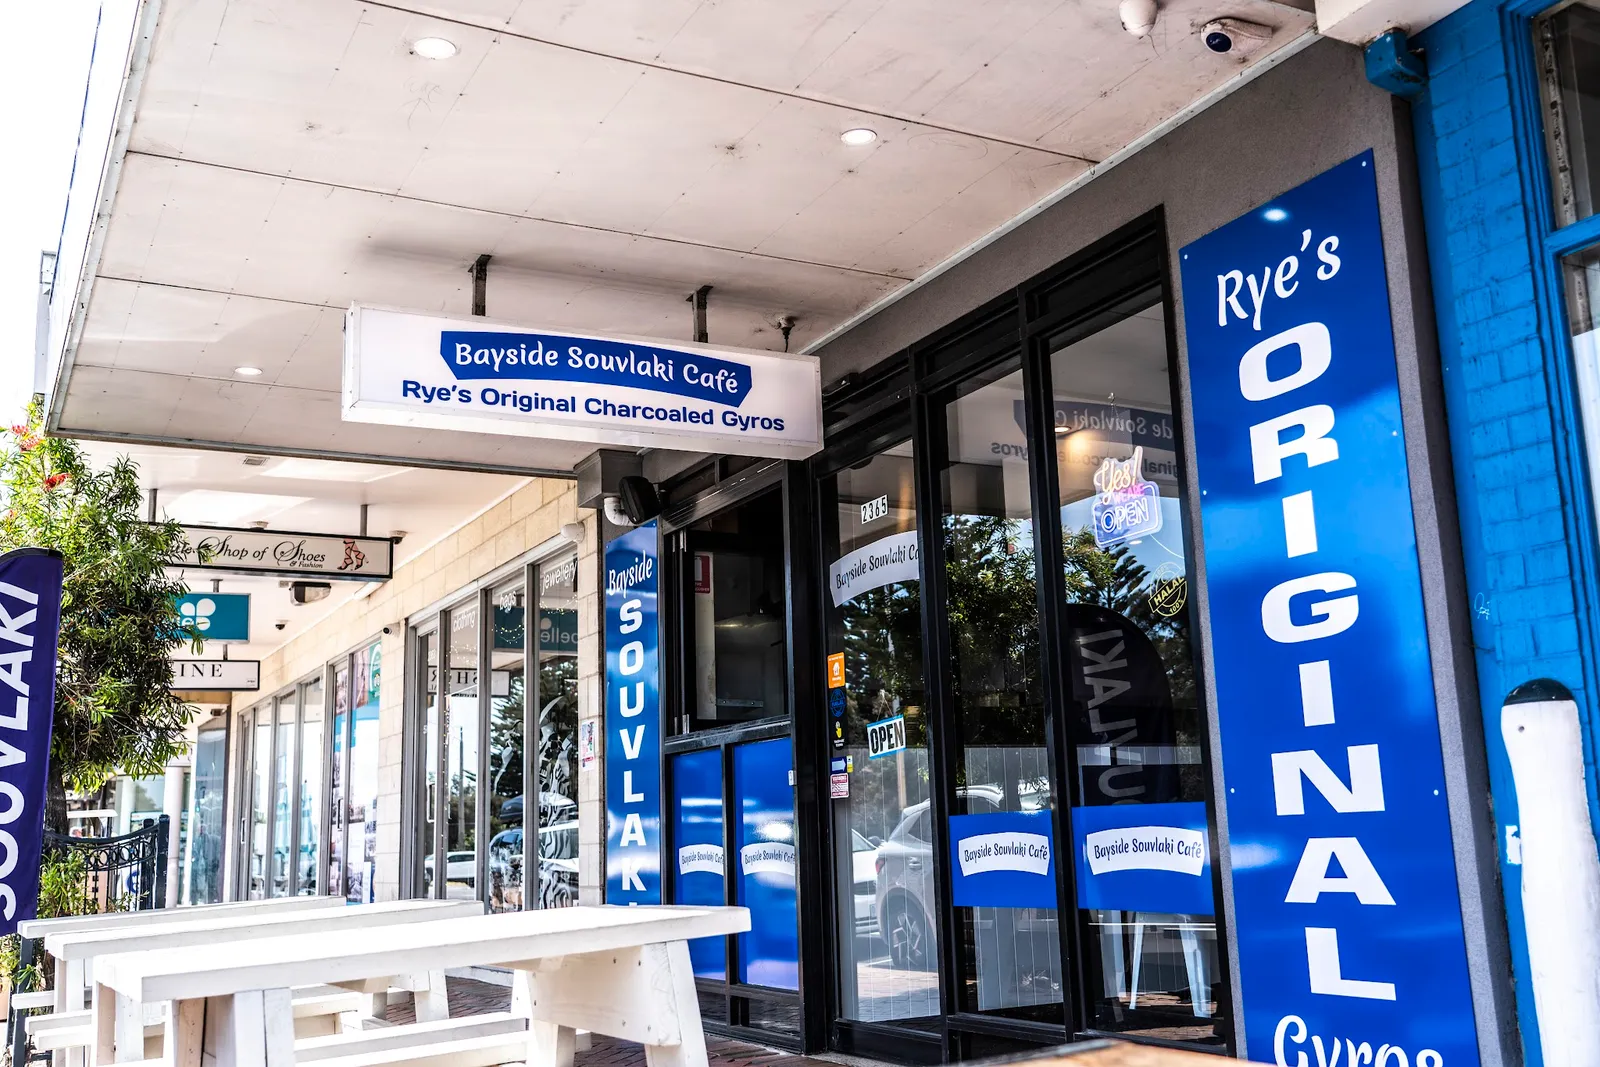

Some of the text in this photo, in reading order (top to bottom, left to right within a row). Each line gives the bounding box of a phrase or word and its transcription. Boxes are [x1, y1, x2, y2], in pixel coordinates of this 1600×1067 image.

[1216, 228, 1341, 330] Rye's
[454, 340, 739, 394] Bayside Souvlaki Café
[402, 380, 785, 432] Rye's Original Charcoaled Gyros
[863, 497, 887, 522] 2365
[1101, 497, 1150, 533] OPEN
[197, 535, 249, 561] Shop
[252, 547, 269, 561] of
[274, 540, 325, 565] Shoes
[298, 560, 323, 568] Fashion
[836, 544, 919, 589] Bayside Souvlaki Ca
[608, 550, 653, 598] Bayside
[1153, 576, 1185, 606] HALAL
[180, 663, 222, 678] INE
[1238, 321, 1397, 1001] ORIGINAL
[0, 580, 39, 921] VLAKI
[619, 598, 647, 906] SOUVLAK
[869, 720, 904, 754] OPEN
[964, 839, 1048, 863] Bayside Souvlaki Café
[1094, 836, 1201, 861] Bayside Souvlaki Café
